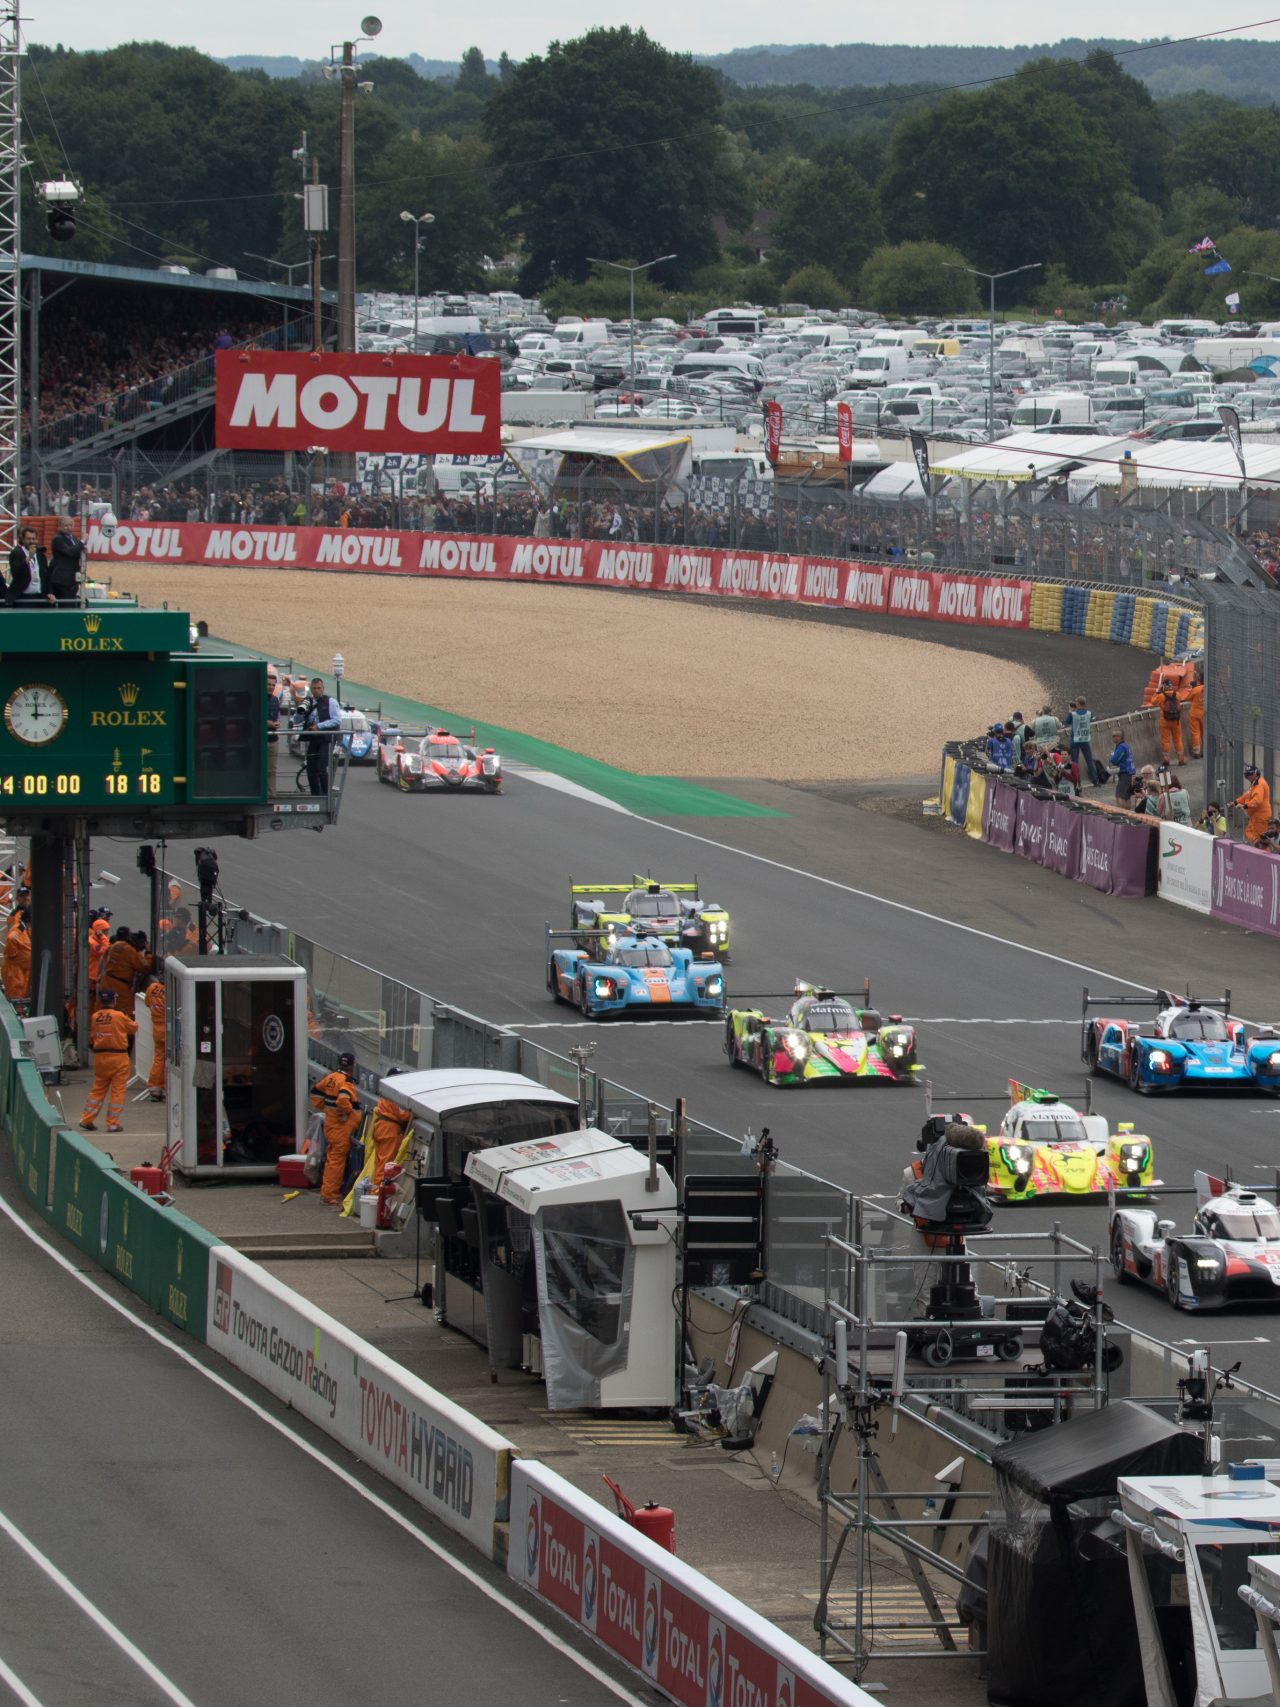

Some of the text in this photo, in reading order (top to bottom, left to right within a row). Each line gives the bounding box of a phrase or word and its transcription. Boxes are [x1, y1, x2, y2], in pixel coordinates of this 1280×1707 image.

[229, 374, 487, 433] MOTUL
[86, 525, 183, 558] MOTUL
[204, 531, 296, 562] MOTUL
[316, 533, 402, 567] MOTUL
[419, 539, 496, 572] MOTUL
[510, 543, 583, 576] MOTUL
[597, 549, 653, 583] MOTUL
[665, 554, 712, 588] MOTUL
[719, 558, 758, 591] MOTUL
[760, 561, 798, 594] MOTUL
[804, 565, 839, 599] MOTUL
[846, 570, 883, 607] MOTUL
[893, 575, 929, 612] MOTUL
[938, 581, 976, 618] MOTUL
[981, 585, 1023, 621] MOTUL
[60, 638, 123, 651] ROLEX
[91, 711, 167, 726] ROLEX
[0, 775, 81, 795] 4:00:00
[105, 775, 129, 794] 18
[138, 774, 161, 793] 18
[1225, 876, 1236, 898] PAYS
[1237, 880, 1243, 900] DE
[1250, 884, 1263, 909] LOIRE
[66, 1202, 84, 1237] ROLEX
[116, 1244, 133, 1280] ROLEX
[1266, 1253, 1279, 1264] 8
[168, 1284, 188, 1322] ROLEX
[304, 1349, 338, 1419] Racing
[359, 1375, 474, 1520] TOYOTA HYBRID
[543, 1521, 580, 1596] TOTAL
[601, 1564, 640, 1641] TOTAL
[663, 1607, 705, 1685] TOTAL
[728, 1653, 769, 1707] TOTA
